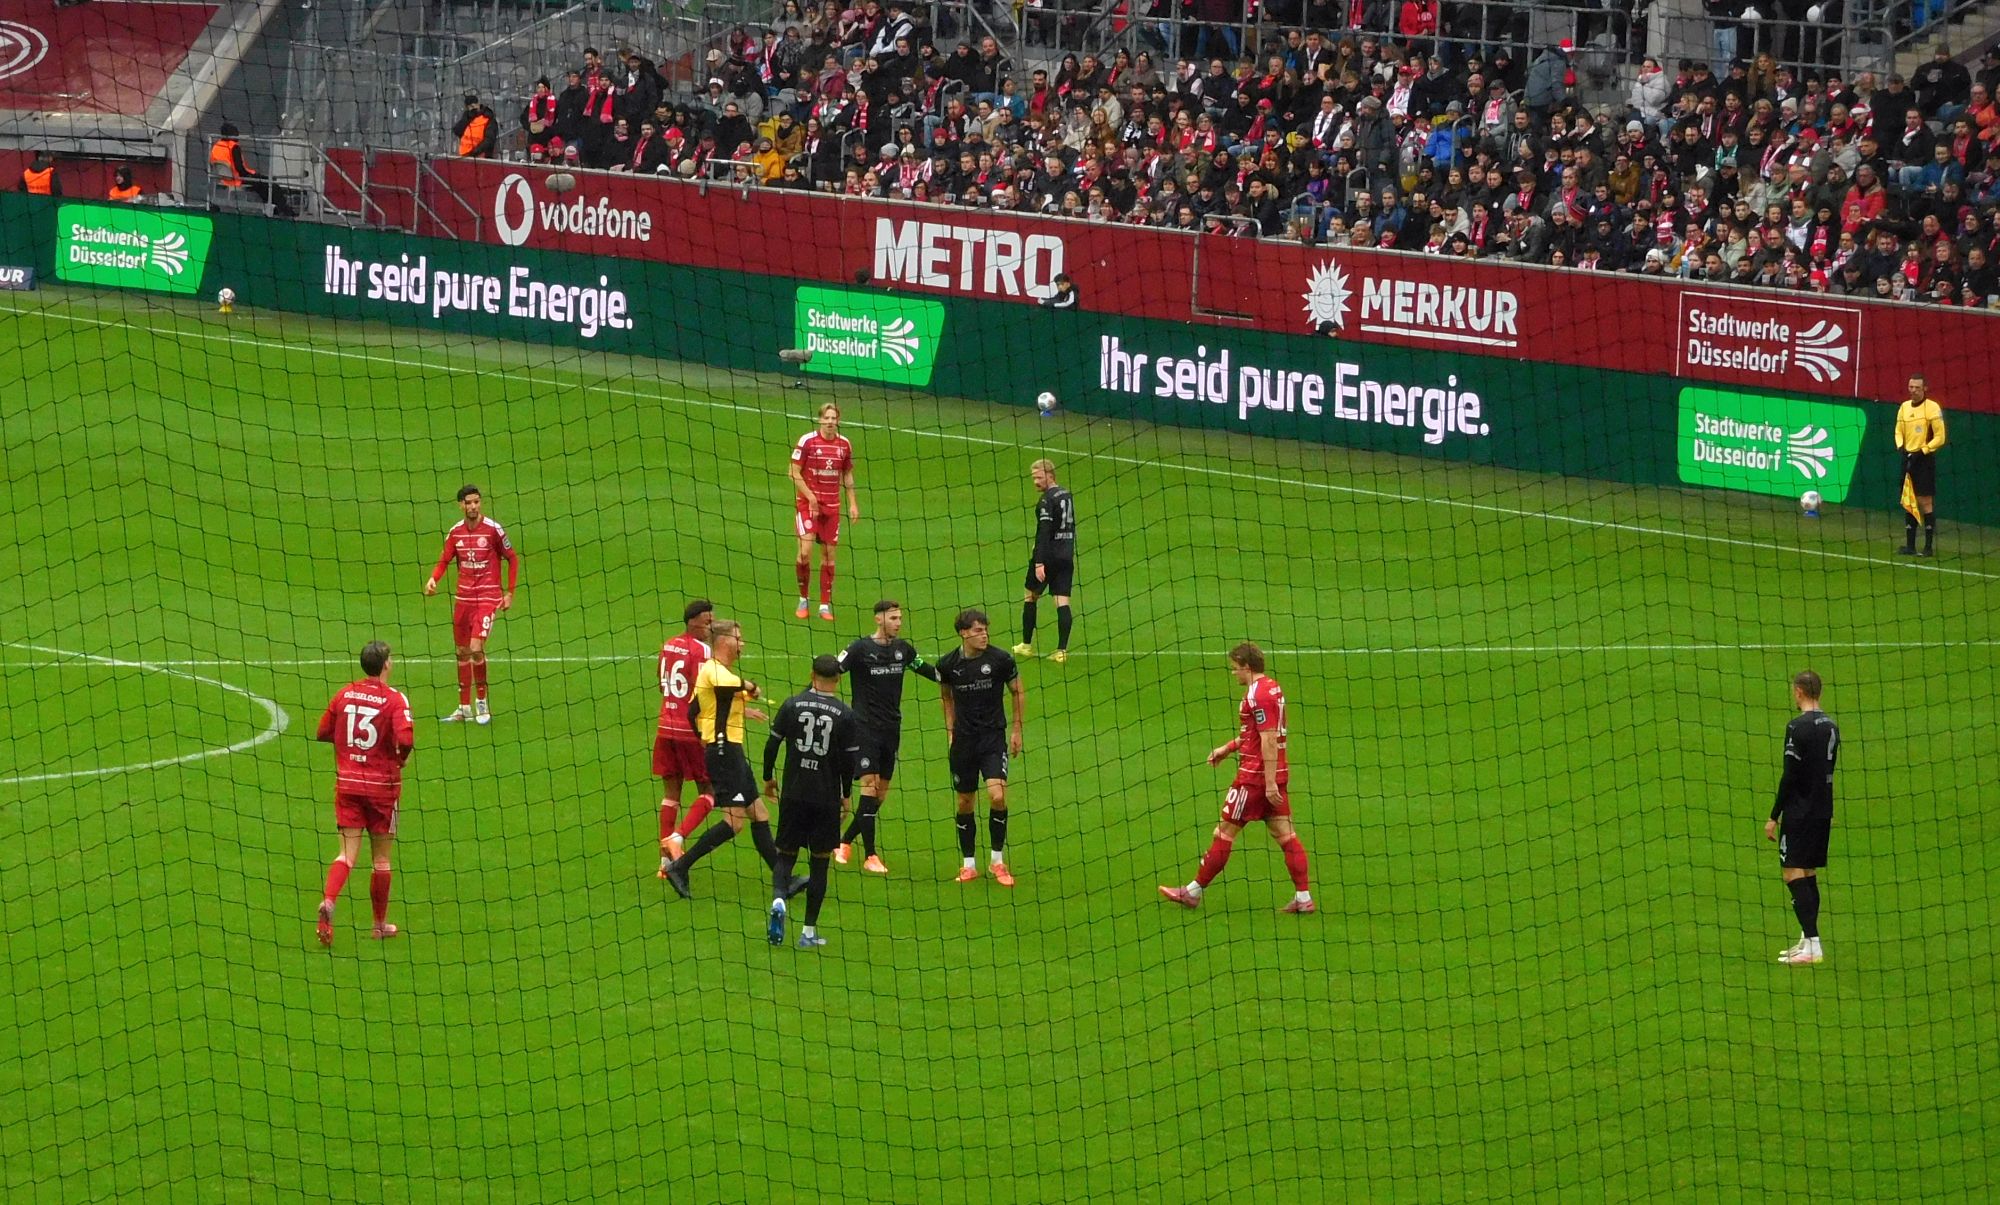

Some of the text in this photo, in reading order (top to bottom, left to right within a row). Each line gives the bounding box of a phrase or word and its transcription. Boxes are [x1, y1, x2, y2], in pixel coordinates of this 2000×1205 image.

[71, 224, 148, 248] Stadtwerke
[540, 196, 651, 241] vodafone
[70, 245, 147, 269] Düsseldorf
[874, 217, 1063, 298] METRO
[325, 245, 632, 337] Ihr seid pure Energie.
[1361, 277, 1517, 334] MERKUR
[808, 308, 877, 334] Stadtwerke
[1689, 309, 1790, 342] Stadtwerke
[808, 333, 877, 358] Düsseldorf
[1688, 339, 1788, 374] Düsseldorf
[1101, 335, 1489, 444] Ihr seid pure Energie.
[1695, 413, 1782, 442] Stadtwerke
[1694, 440, 1781, 471] Düsseldorf
[482, 616, 490, 629] 8
[661, 657, 688, 698] 46
[344, 704, 380, 750] 13
[795, 711, 833, 756] 33
